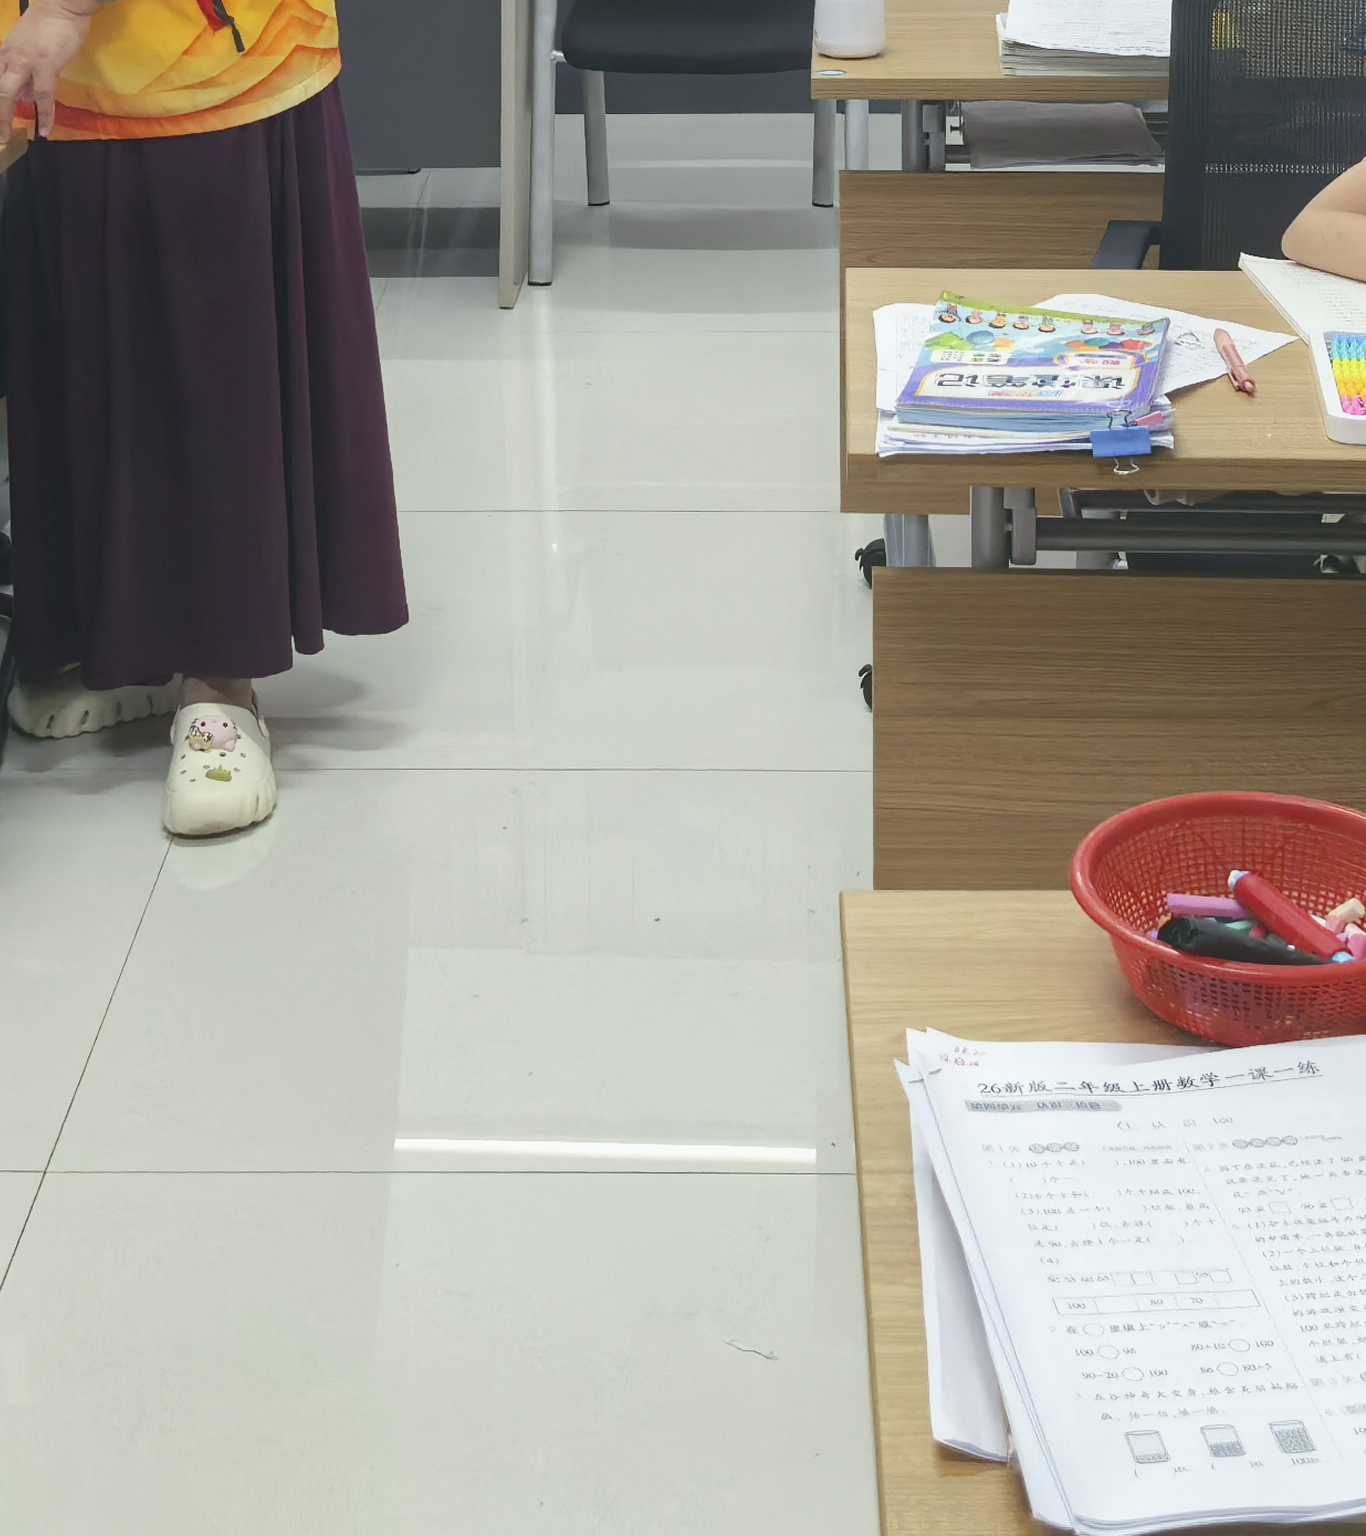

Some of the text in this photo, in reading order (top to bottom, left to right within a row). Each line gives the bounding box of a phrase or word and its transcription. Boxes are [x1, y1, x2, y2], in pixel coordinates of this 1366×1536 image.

[933, 372, 1127, 392] 课堂笔记
[977, 1059, 1321, 1095] 26新版二年级上册数学一课一练
